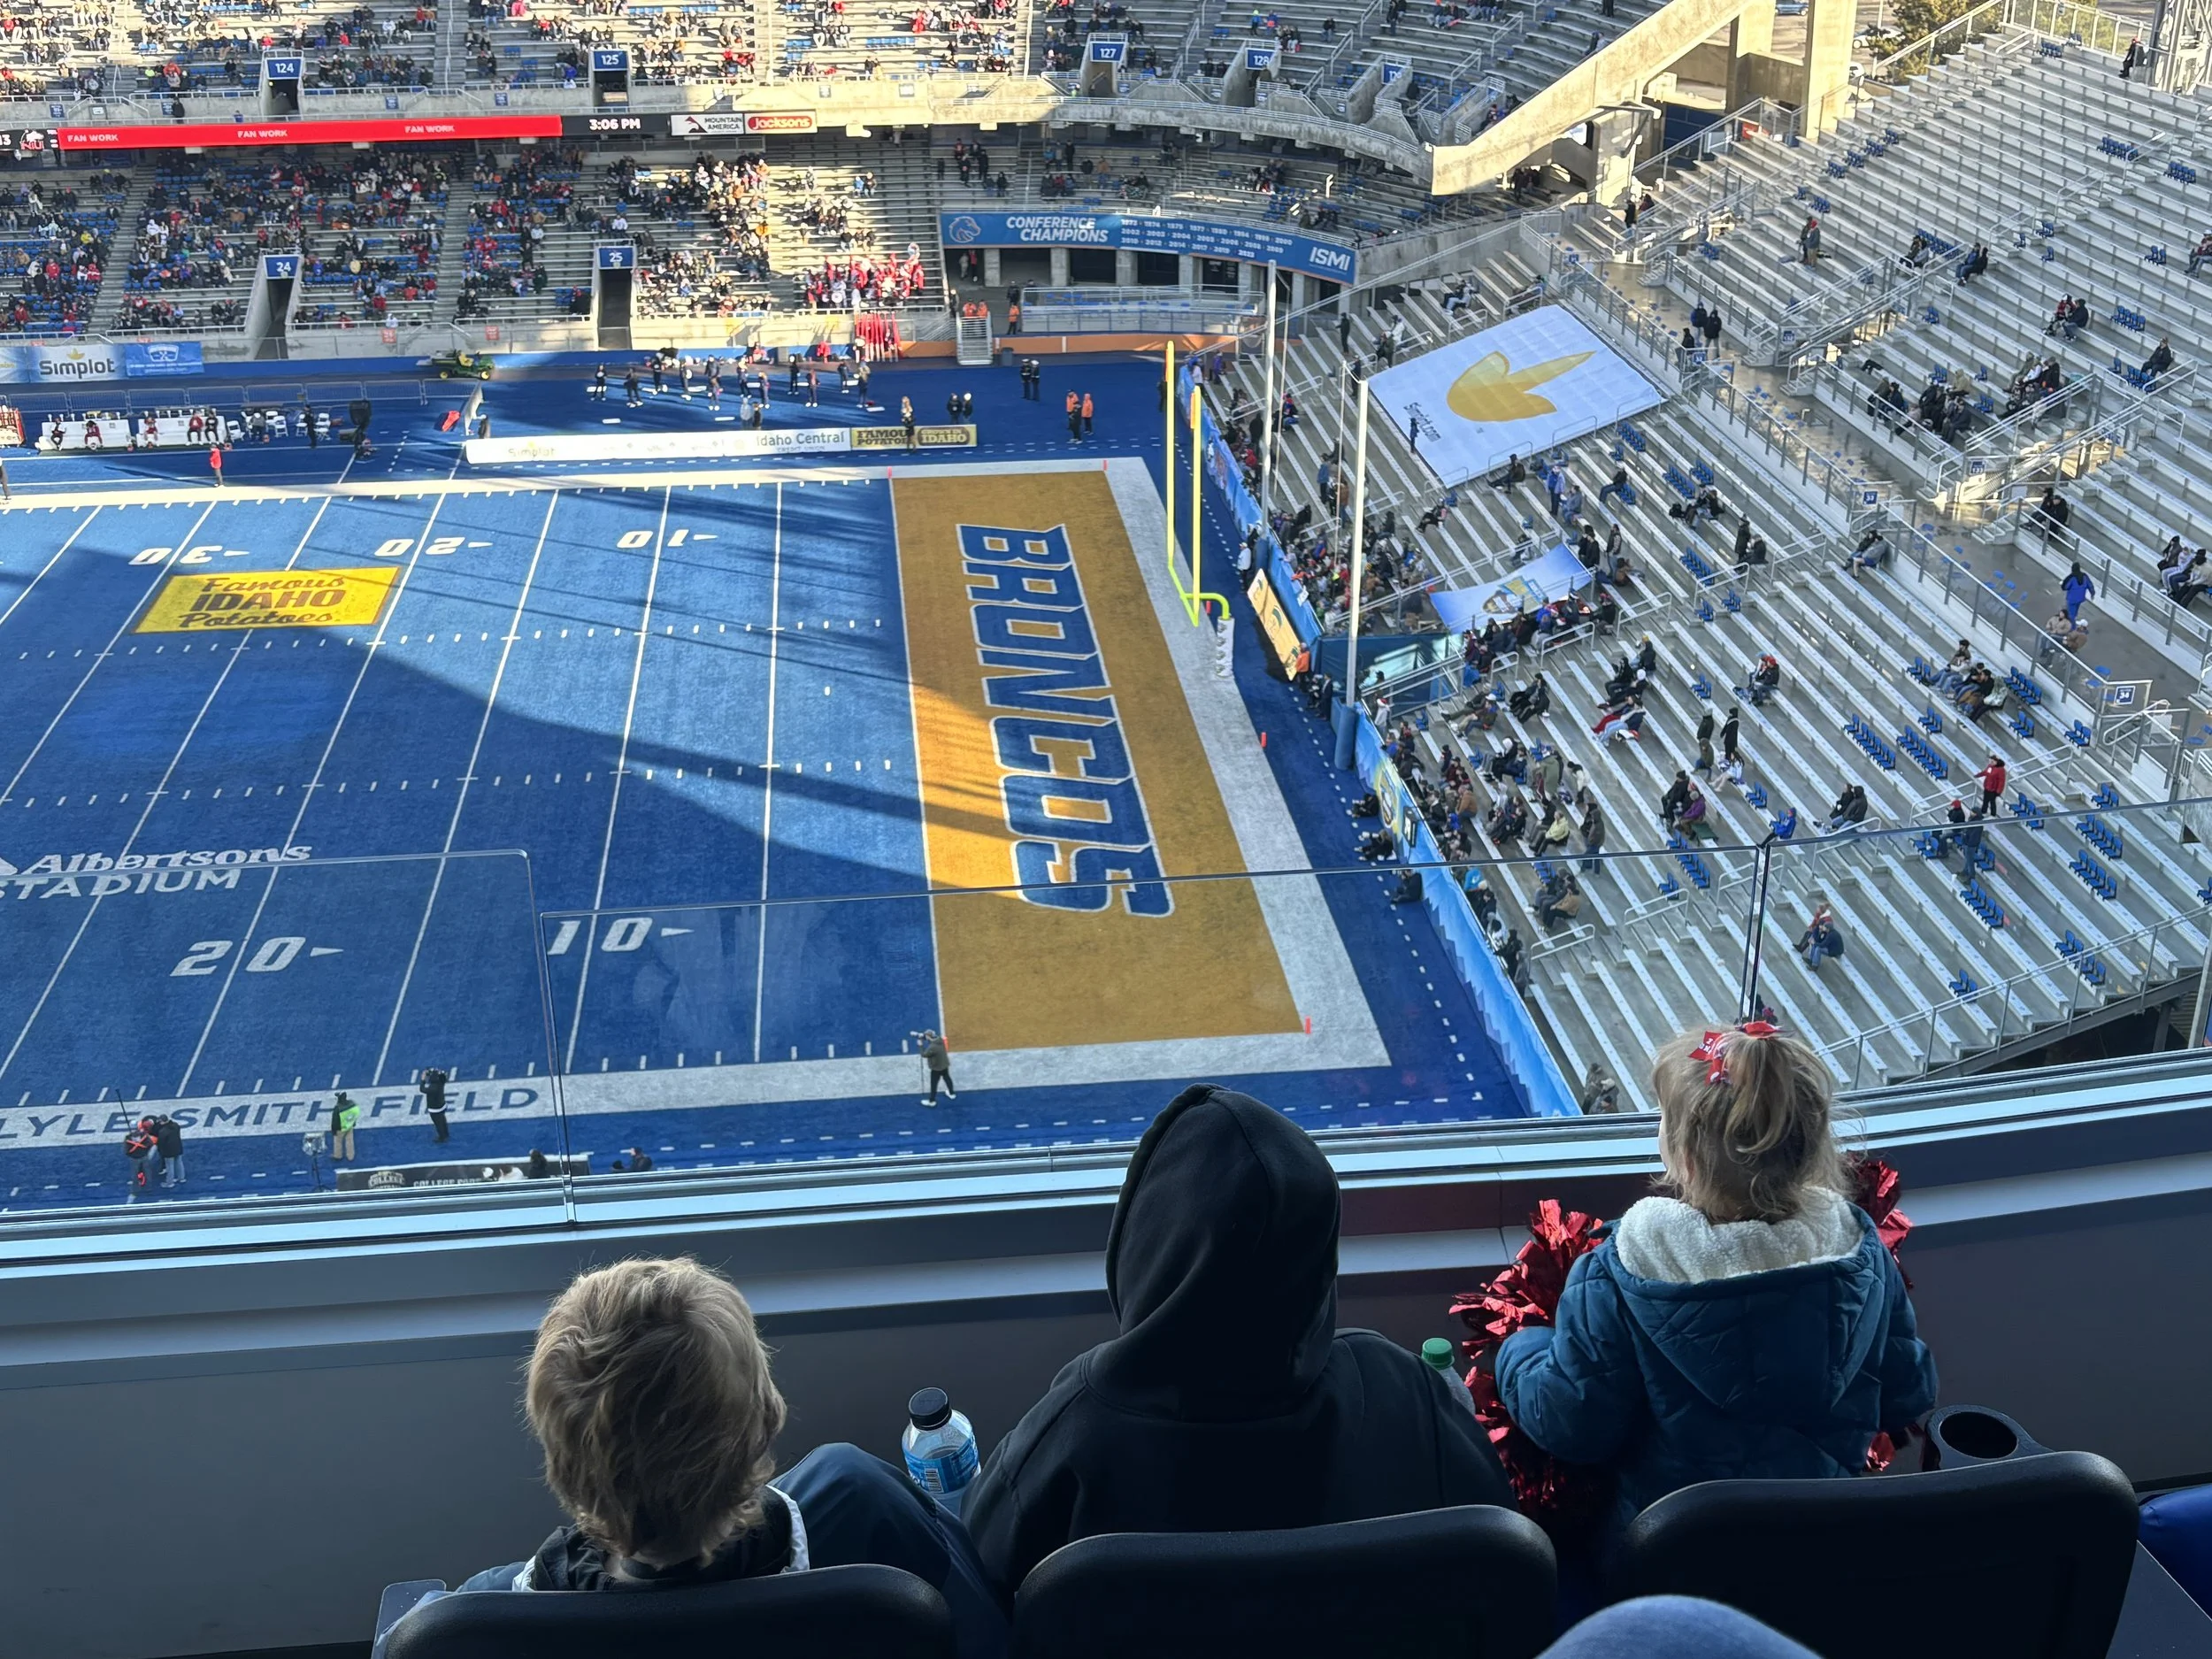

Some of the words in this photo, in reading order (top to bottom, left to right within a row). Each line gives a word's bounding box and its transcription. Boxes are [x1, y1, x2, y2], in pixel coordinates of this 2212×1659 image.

[601, 54, 619, 65] 125
[1099, 48, 1117, 58] 127
[1254, 55, 1270, 66] 128
[274, 63, 295, 73] 124
[589, 119, 618, 131] 3:06
[621, 118, 641, 130] PM
[704, 116, 742, 125] MOUNTAIN
[707, 122, 741, 131] AMERICA
[751, 115, 812, 131] Jacksons
[237, 130, 257, 139] FAN
[258, 129, 288, 138] WORK
[1006, 216, 1096, 229] CONFERENCE
[1019, 227, 1110, 243] CHAMPIONS
[609, 252, 623, 264] 25
[1309, 246, 1351, 272] ISMI
[275, 261, 292, 273] 24
[39, 357, 116, 379] Simplot
[757, 434, 792, 447] Idaho
[796, 431, 844, 444] Central
[856, 429, 907, 439] FAMOU
[856, 437, 907, 446] POTATO
[922, 434, 967, 443] IDAHO
[508, 447, 556, 457] Simplot
[373, 536, 466, 557] 20
[617, 528, 691, 549] 10
[128, 545, 223, 565] 30
[202, 576, 345, 592] Famous
[191, 588, 346, 611] IDAHO
[178, 611, 333, 628] Potatoes
[956, 524, 1175, 917] BRONCOS
[25, 846, 312, 875] Albertsons
[0, 869, 242, 900] TADIUM
[547, 917, 653, 956] 10
[169, 936, 306, 977] 20
[0, 1110, 141, 1140] LYLE
